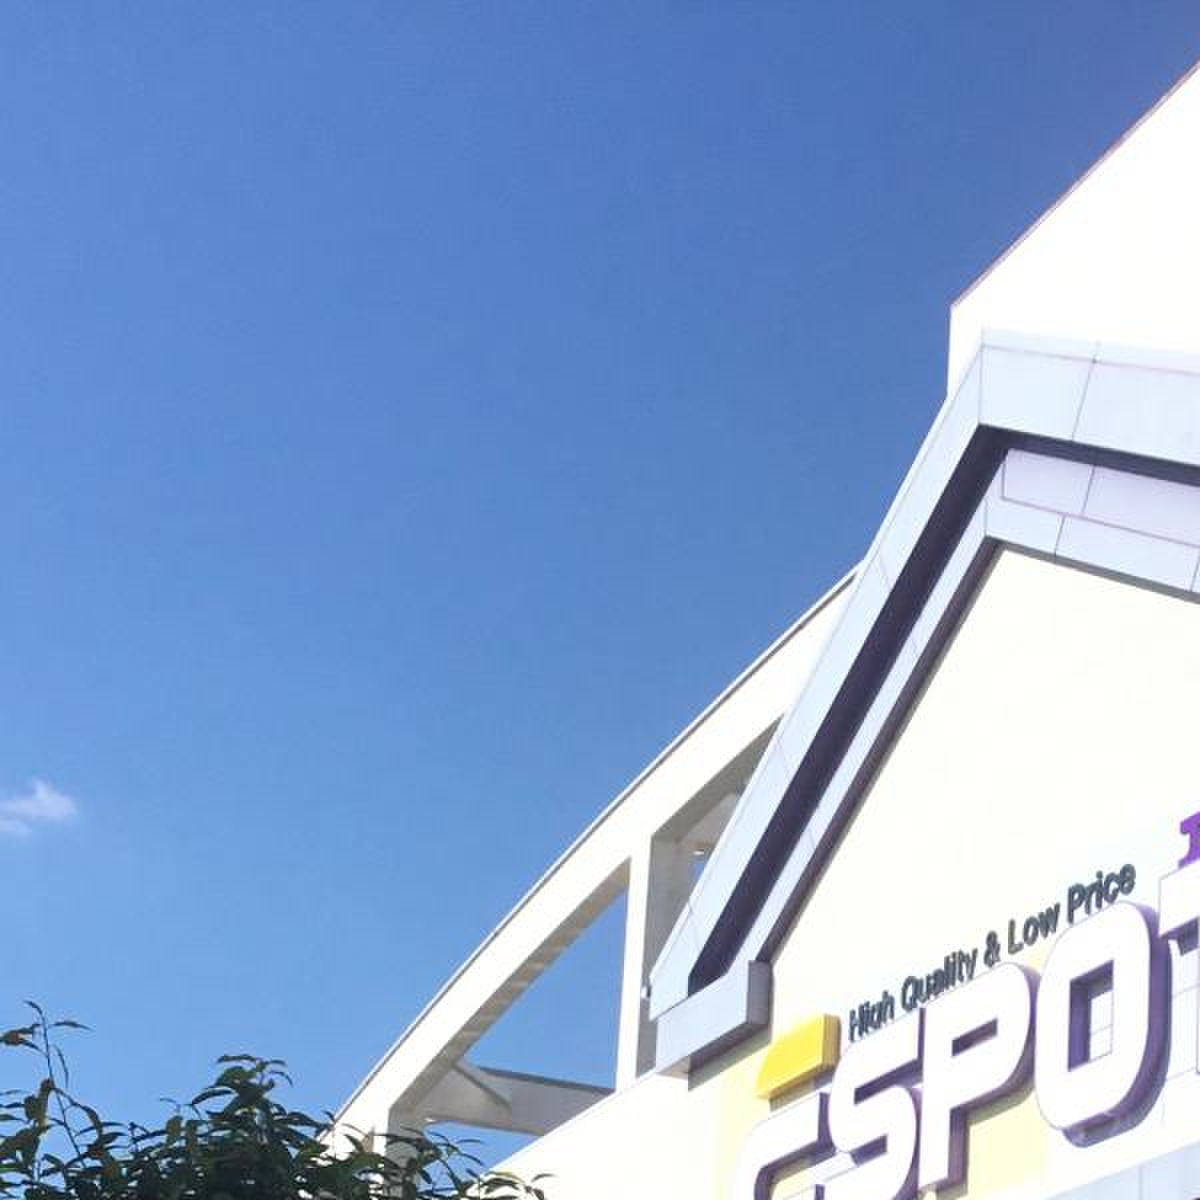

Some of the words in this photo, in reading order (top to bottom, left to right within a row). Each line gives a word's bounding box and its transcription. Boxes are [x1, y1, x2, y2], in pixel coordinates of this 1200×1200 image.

[848, 990, 895, 1043] High
[901, 947, 978, 1012] Quality
[984, 931, 1001, 967] &
[1007, 902, 1061, 955] Low
[1067, 863, 1136, 925] Price
